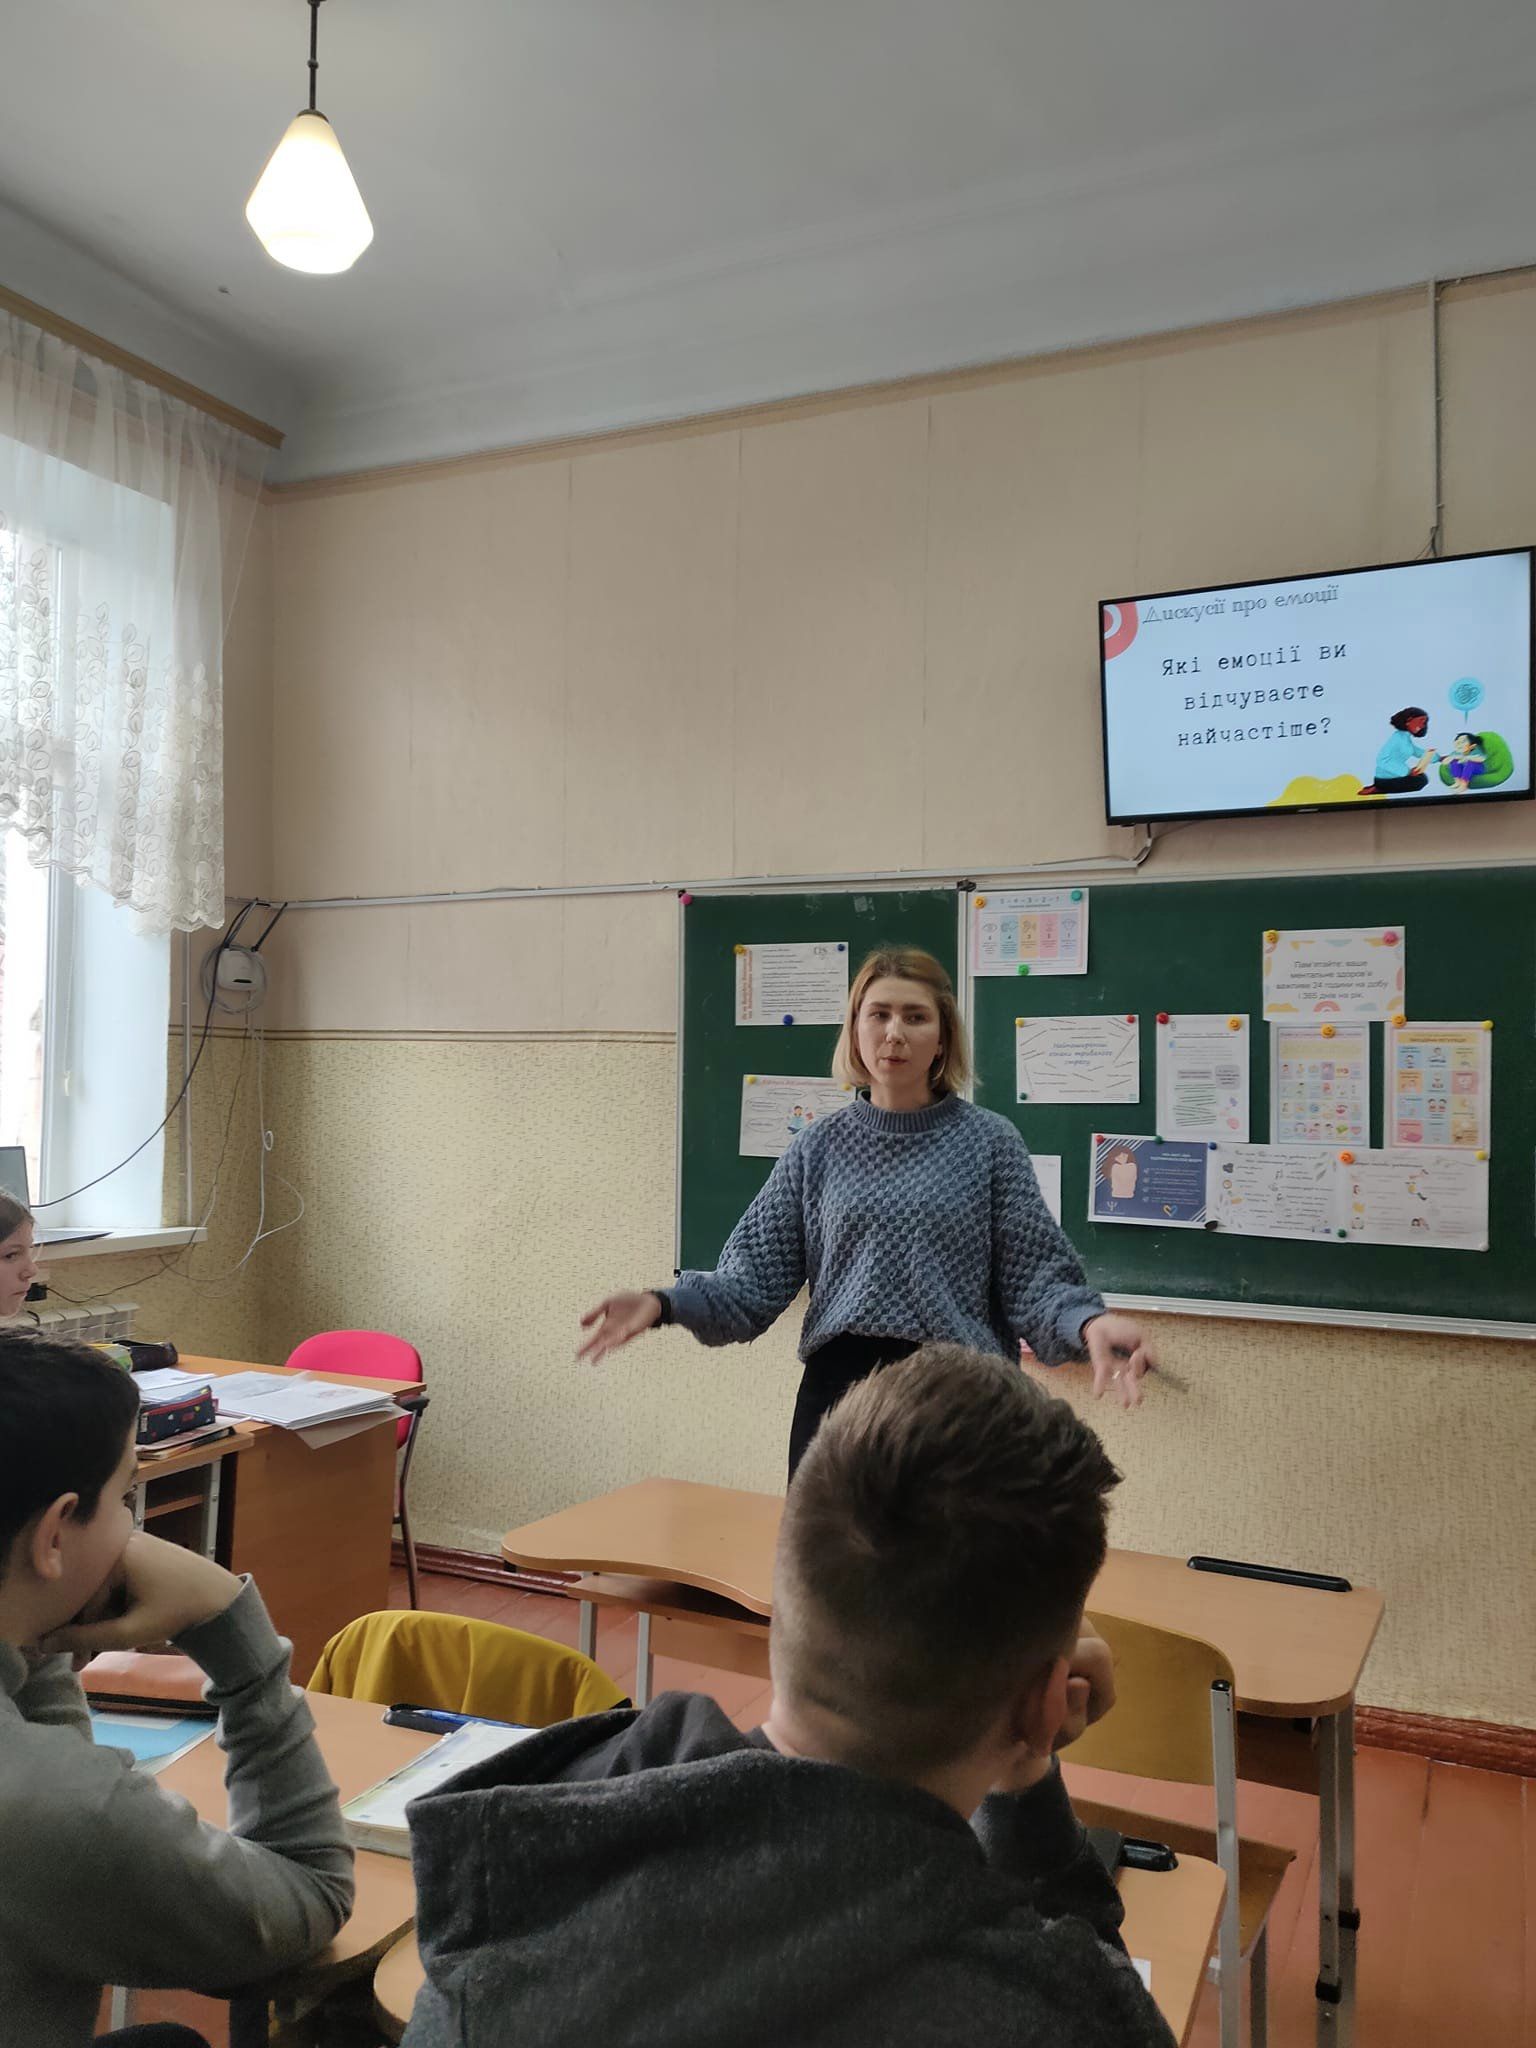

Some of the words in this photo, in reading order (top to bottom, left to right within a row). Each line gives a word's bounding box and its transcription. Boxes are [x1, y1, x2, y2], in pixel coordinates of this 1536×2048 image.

[1142, 597, 1226, 624] Дискусії
[1232, 598, 1267, 617] про
[1275, 584, 1339, 607] емоції
[1162, 656, 1202, 676] Які
[1218, 645, 1302, 669] емоції
[1319, 643, 1347, 660] ви
[1184, 684, 1325, 710] відчуваєте
[1178, 717, 1332, 747] найчастіше?
